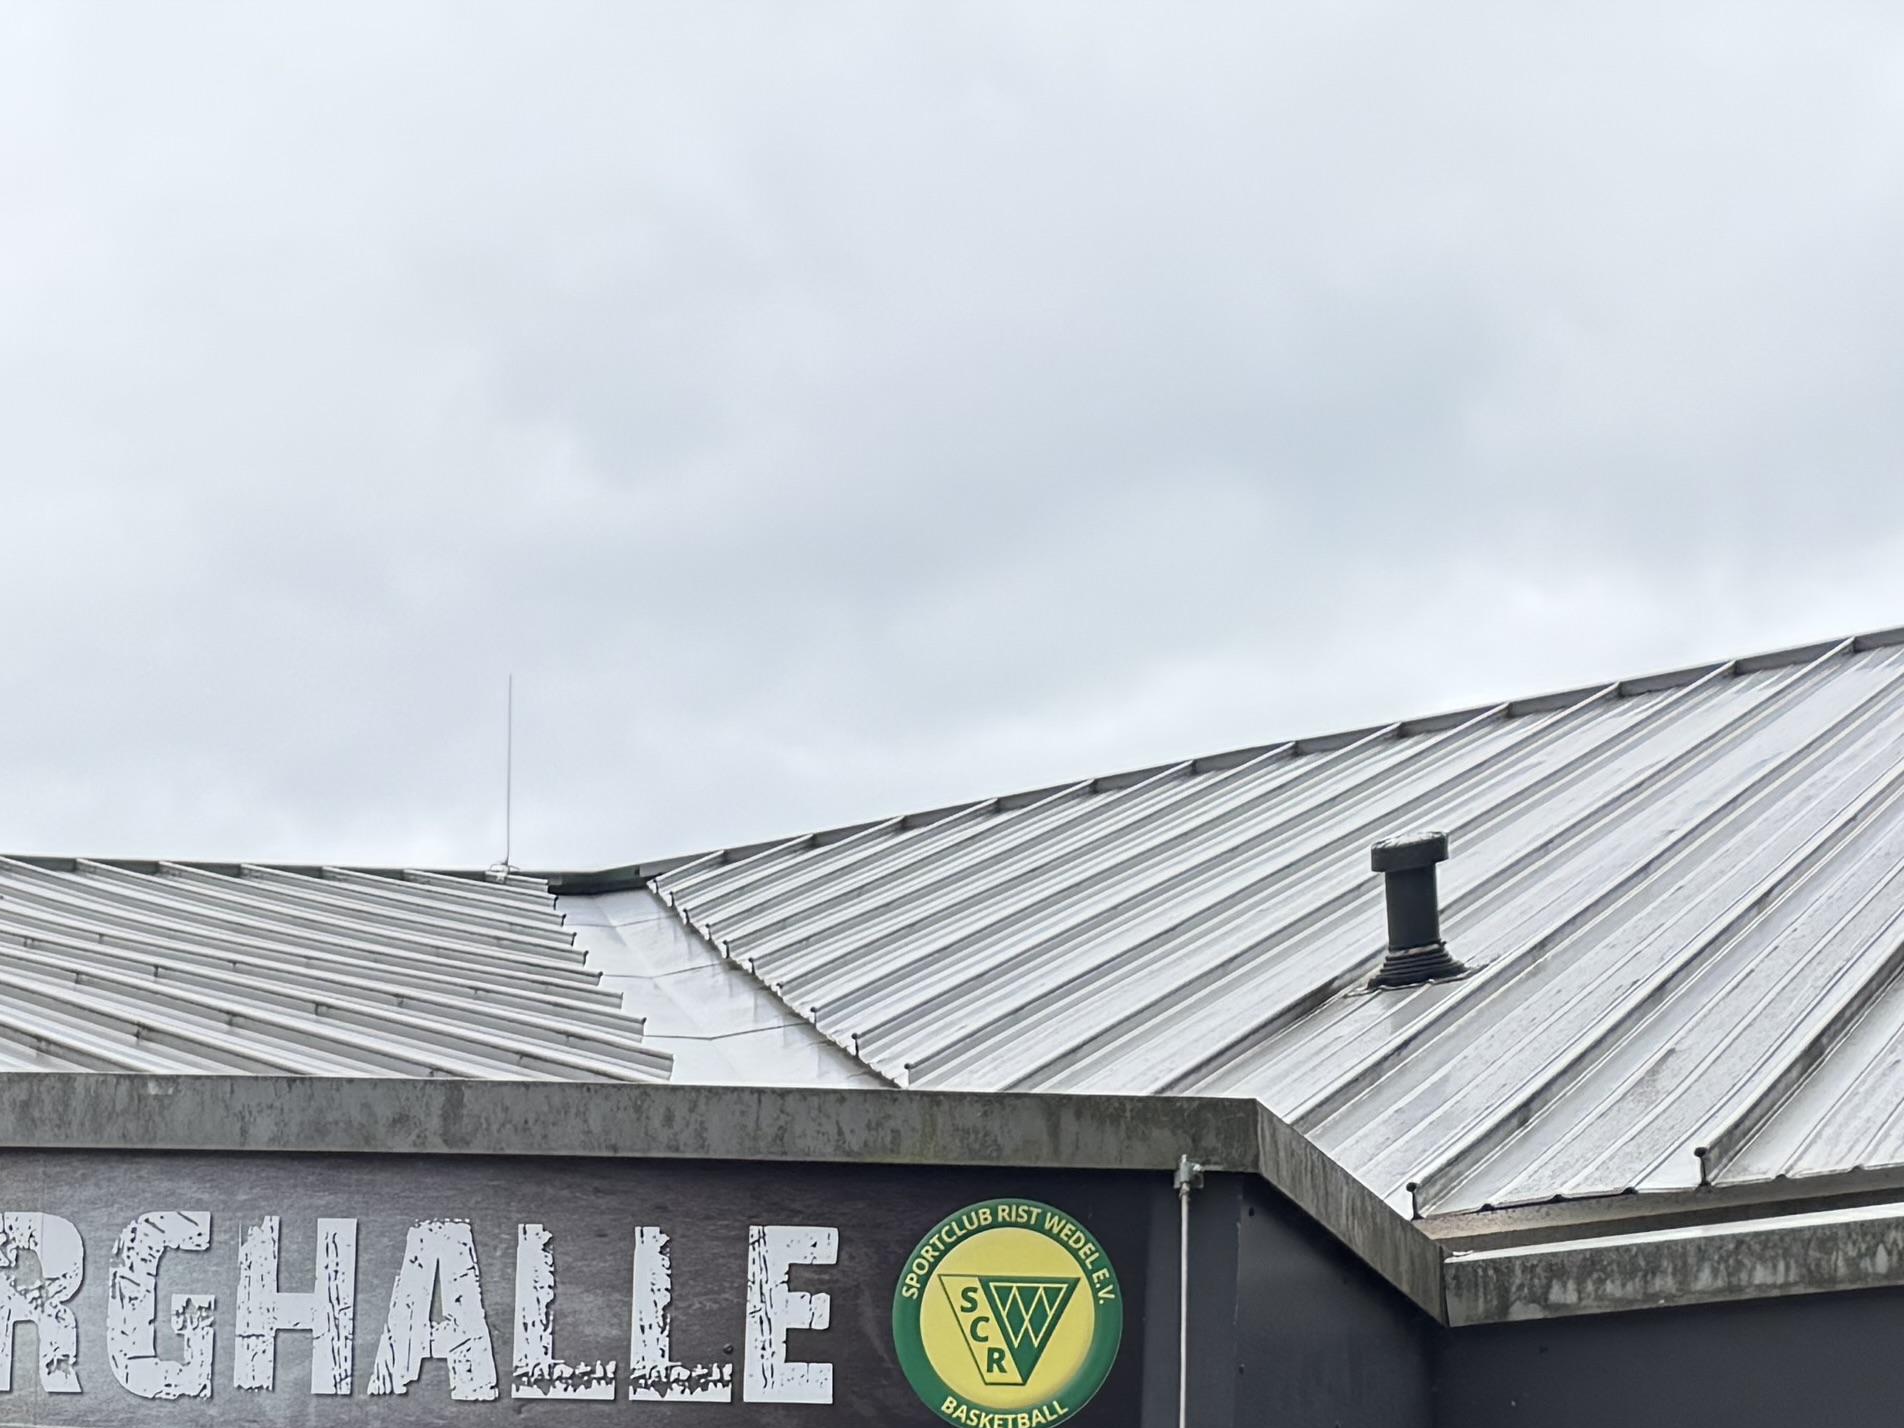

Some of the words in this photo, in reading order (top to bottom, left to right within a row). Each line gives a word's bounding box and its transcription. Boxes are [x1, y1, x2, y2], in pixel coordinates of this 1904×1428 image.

[901, 1207, 993, 1300] SPORTCLUB
[997, 1204, 1042, 1225] RIST
[1043, 1212, 1100, 1270] WEDEL
[1091, 1268, 1116, 1305] E.V.
